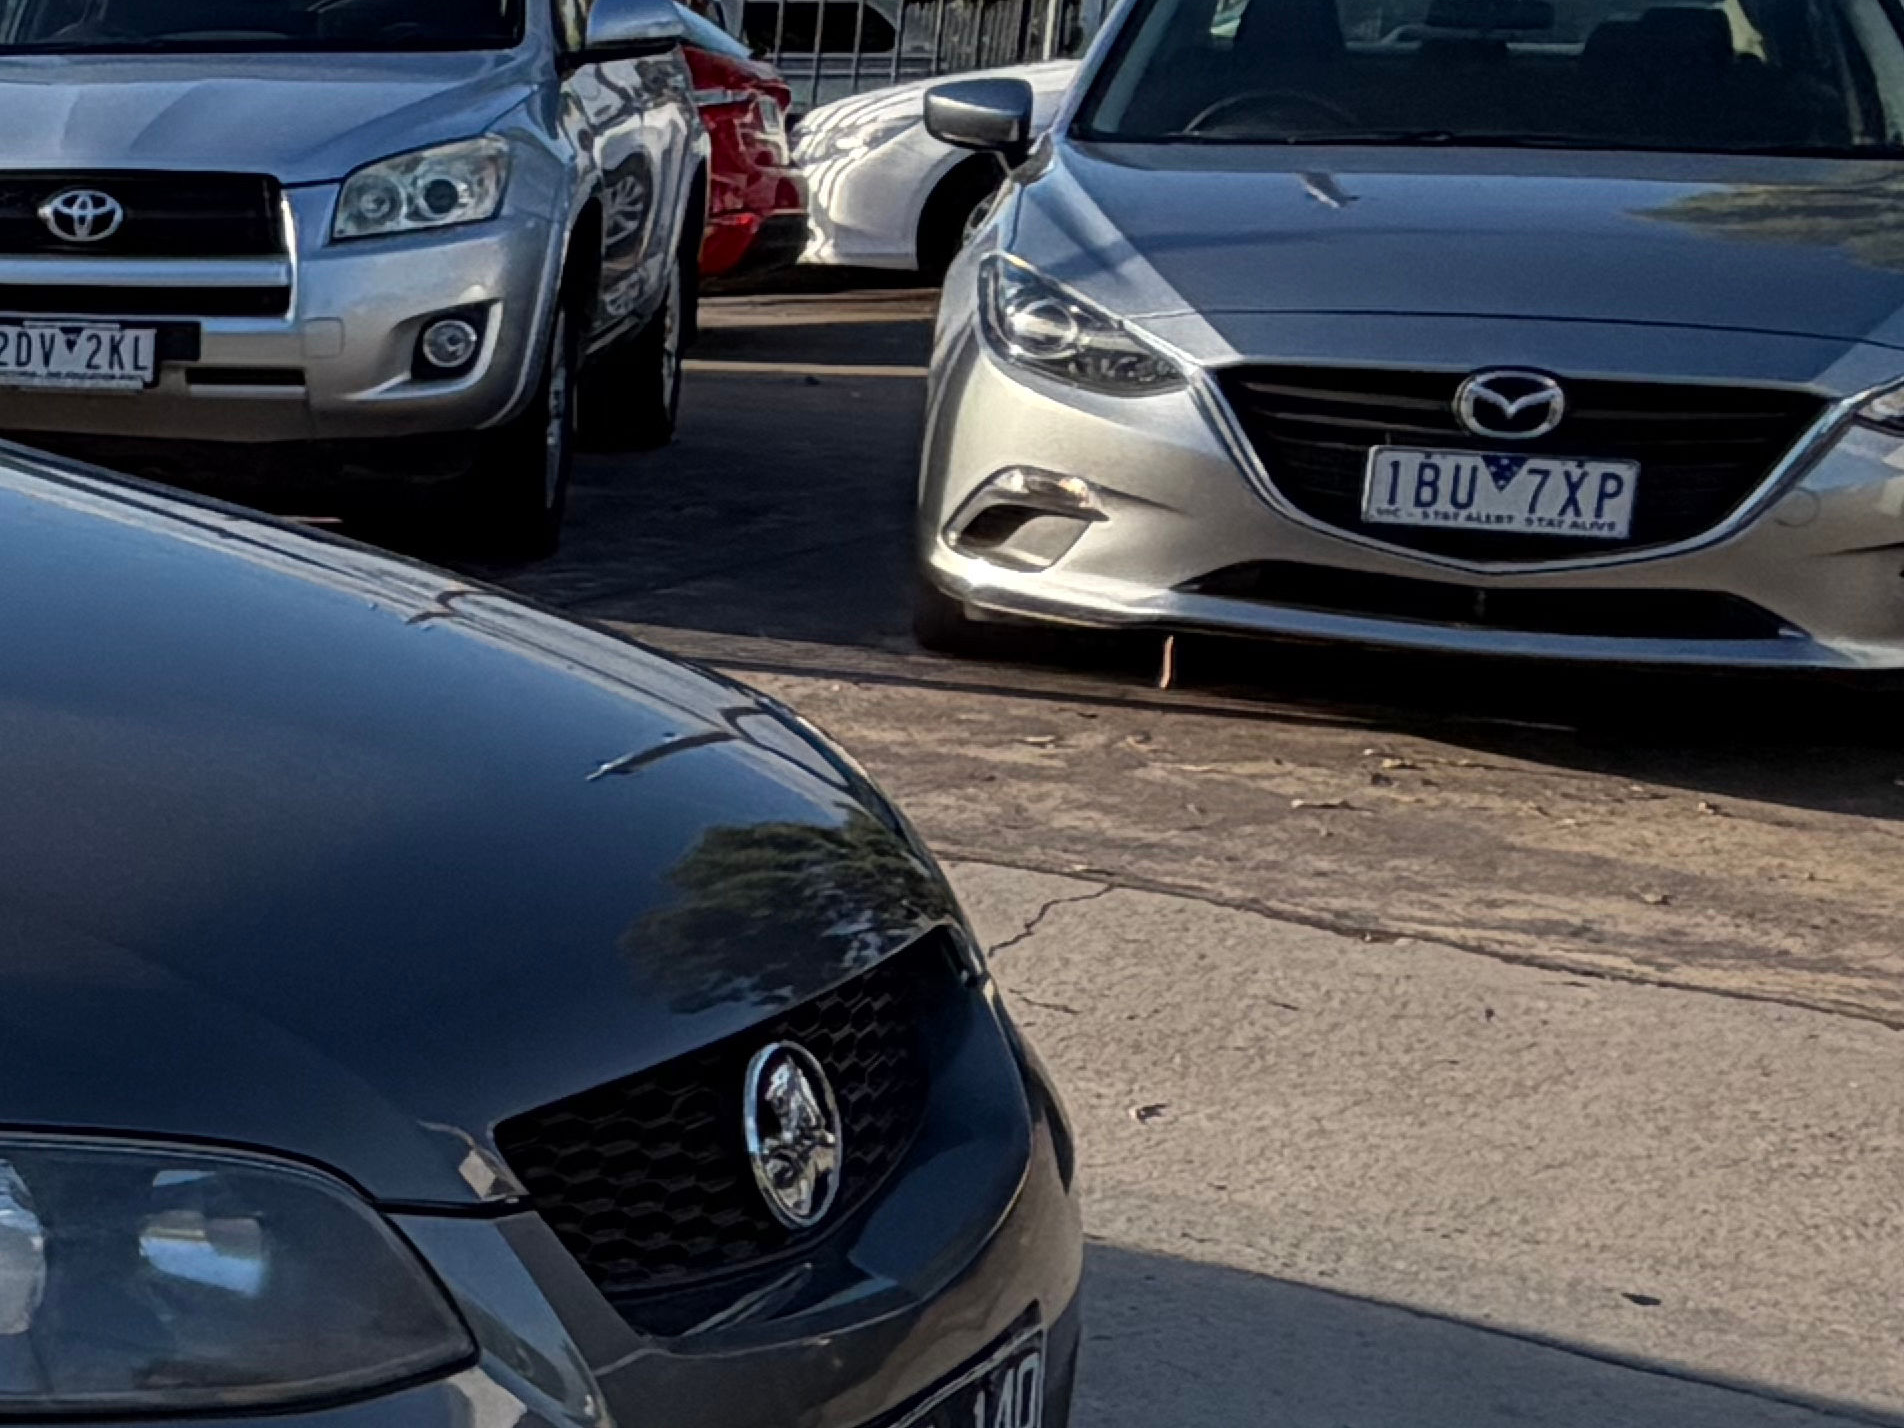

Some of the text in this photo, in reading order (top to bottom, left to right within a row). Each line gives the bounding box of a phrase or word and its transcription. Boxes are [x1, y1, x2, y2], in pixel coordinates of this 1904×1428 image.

[85, 333, 149, 371] 2KL
[1388, 460, 1624, 519] 1BU 7XP
